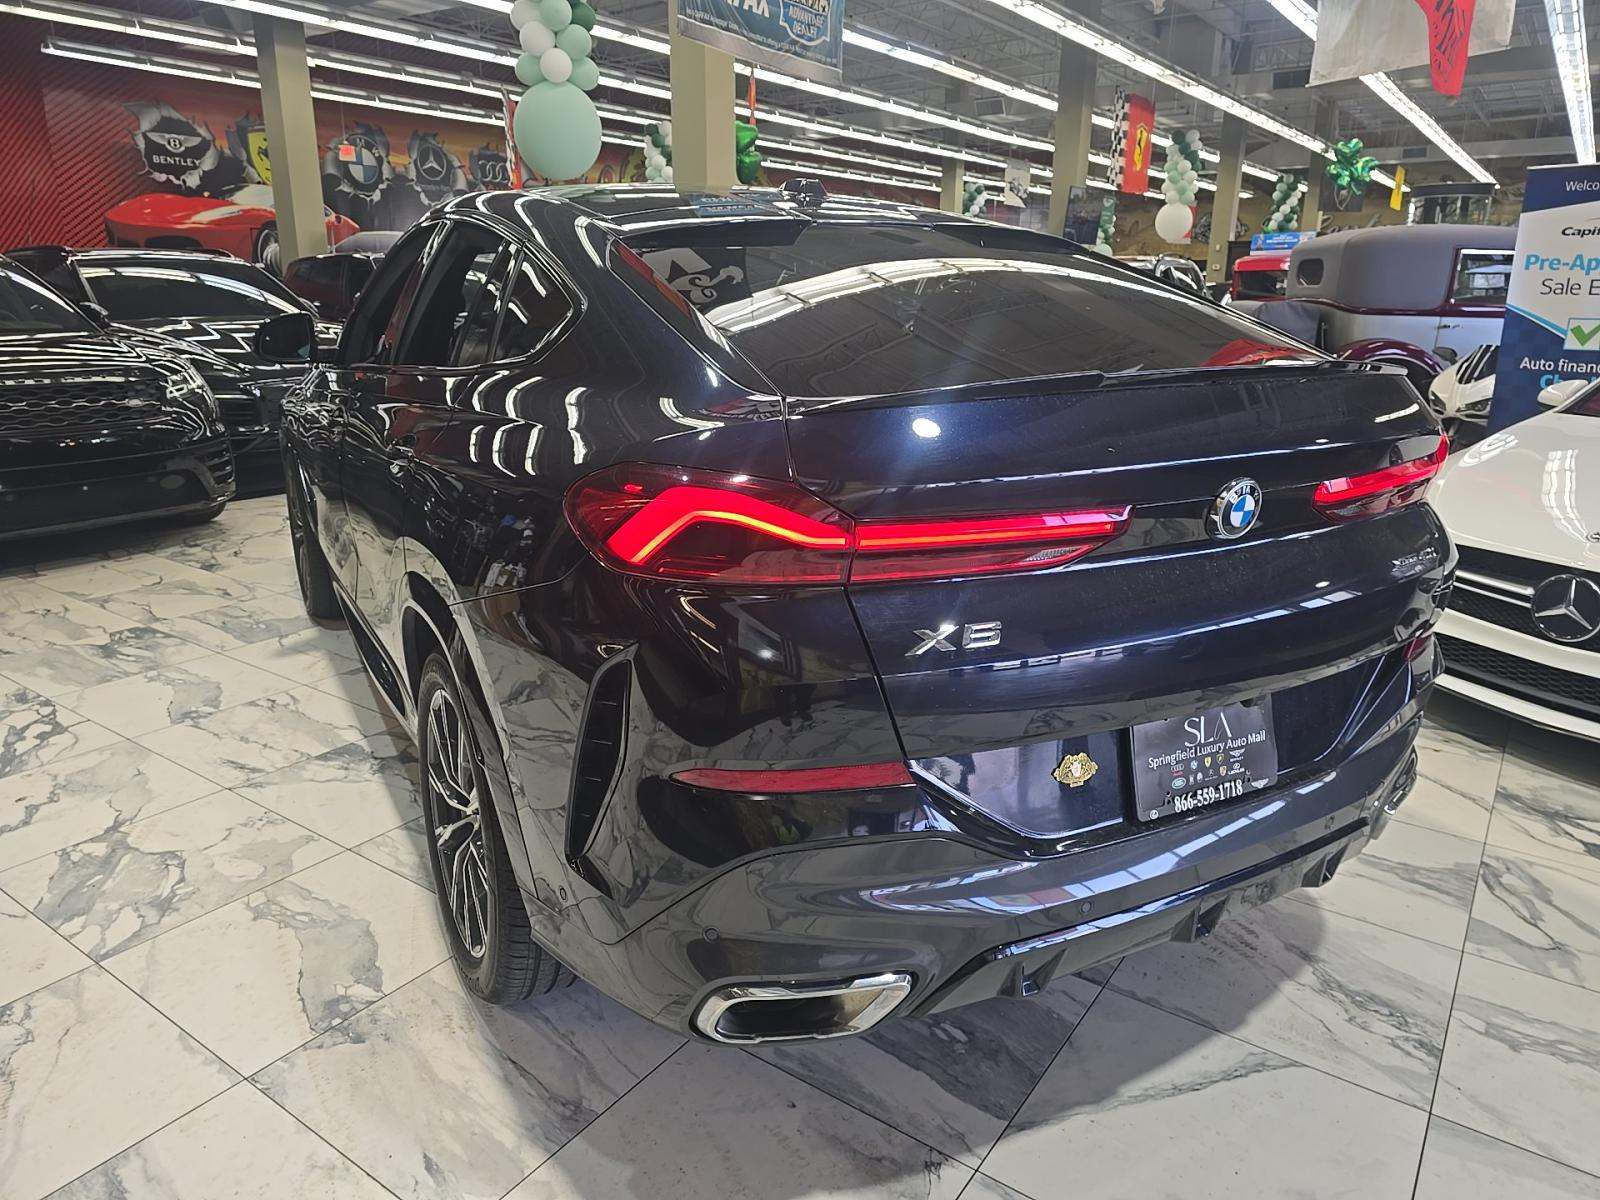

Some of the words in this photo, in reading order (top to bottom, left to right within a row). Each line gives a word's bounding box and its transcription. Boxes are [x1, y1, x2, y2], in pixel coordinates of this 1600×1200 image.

[152, 154, 200, 167] BENTLEY
[1524, 253, 1600, 276] Pre-Ap
[1540, 277, 1581, 296] Sale
[1519, 356, 1555, 371] Auto
[904, 621, 1002, 656] X6
[1184, 711, 1232, 747] SLA
[1148, 746, 1196, 770] Springfield
[1197, 741, 1225, 757] Luxury
[1226, 737, 1247, 749] Auto
[1247, 729, 1266, 744] Mall
[1174, 779, 1243, 813] 866-559-1718
